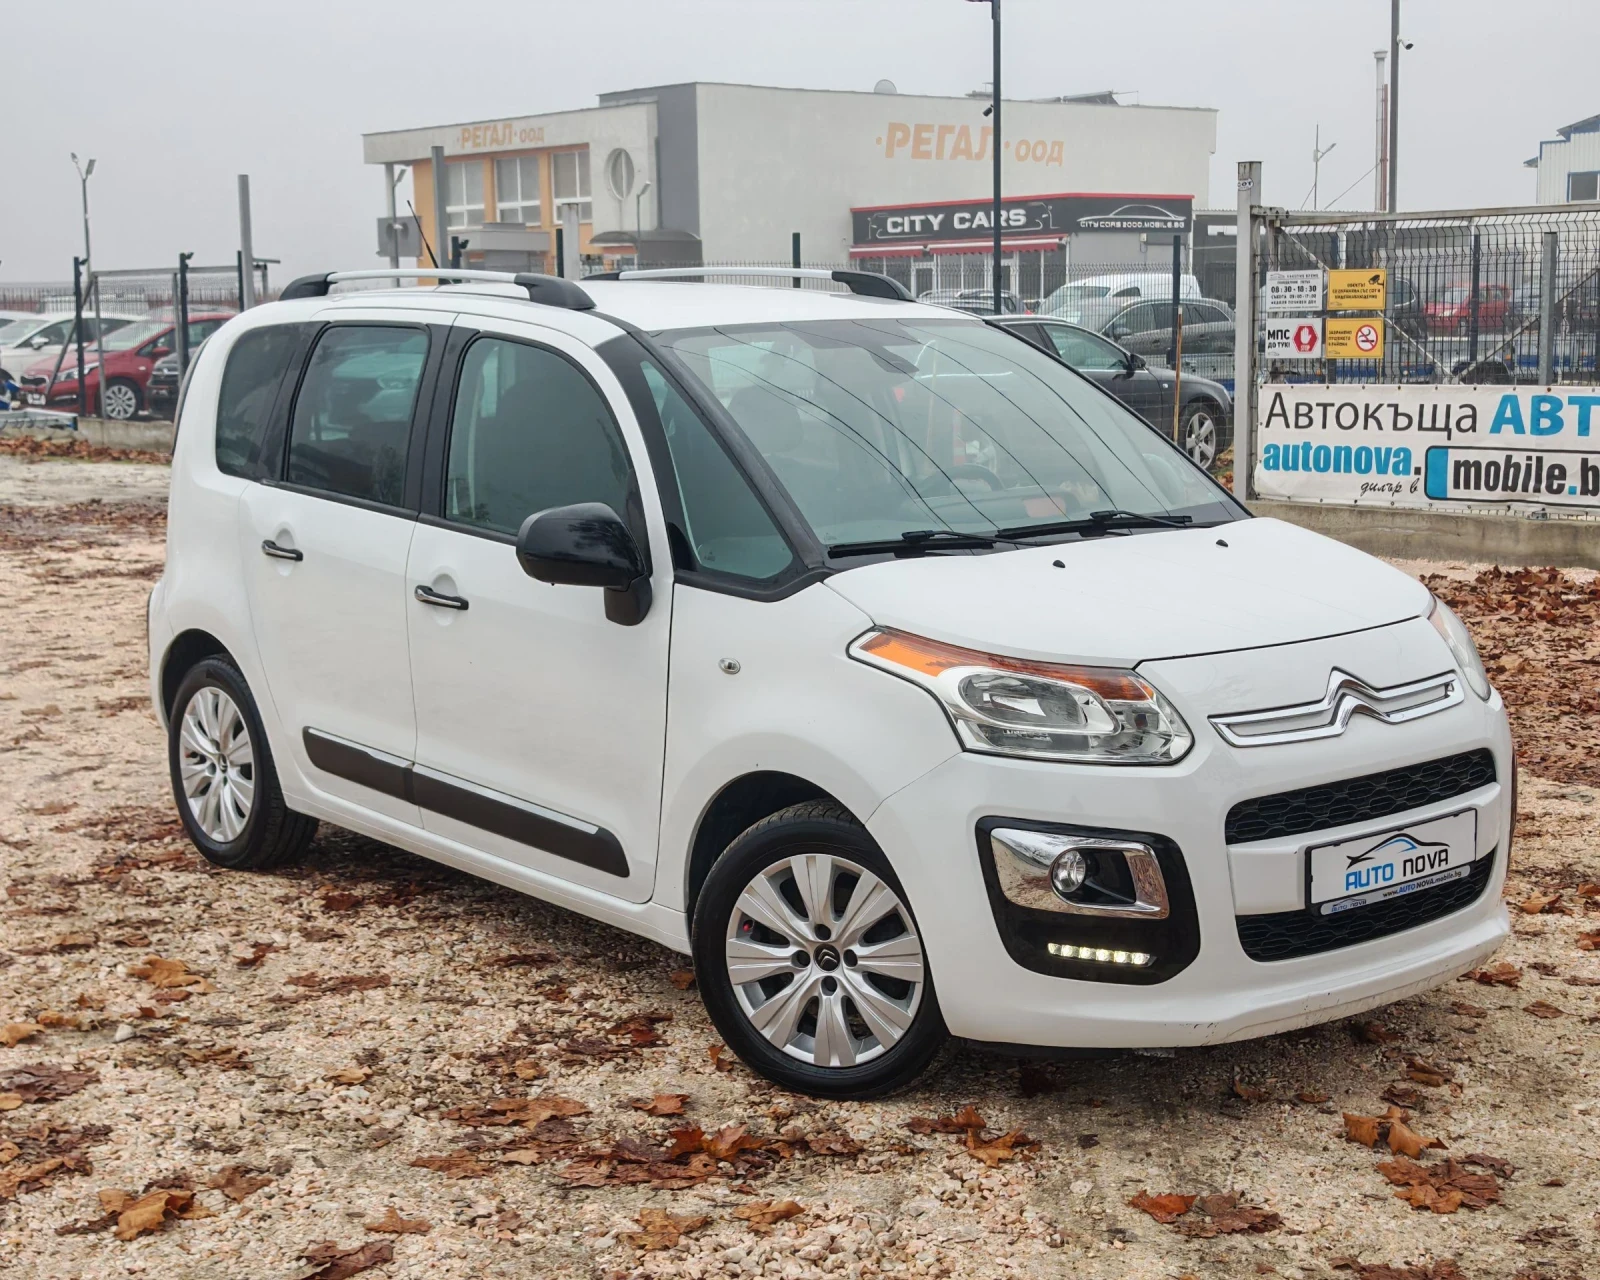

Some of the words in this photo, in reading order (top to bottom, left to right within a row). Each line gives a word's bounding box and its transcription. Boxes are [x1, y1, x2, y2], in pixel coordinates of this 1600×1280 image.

[886, 213, 945, 234] CITY
[953, 208, 1027, 230] CARS
[1267, 329, 1291, 340] МПС
[1267, 341, 1277, 349] ДО
[1264, 391, 1478, 441] Автокъща
[1345, 862, 1394, 892] AUTO
[1402, 848, 1449, 877] NOVA
